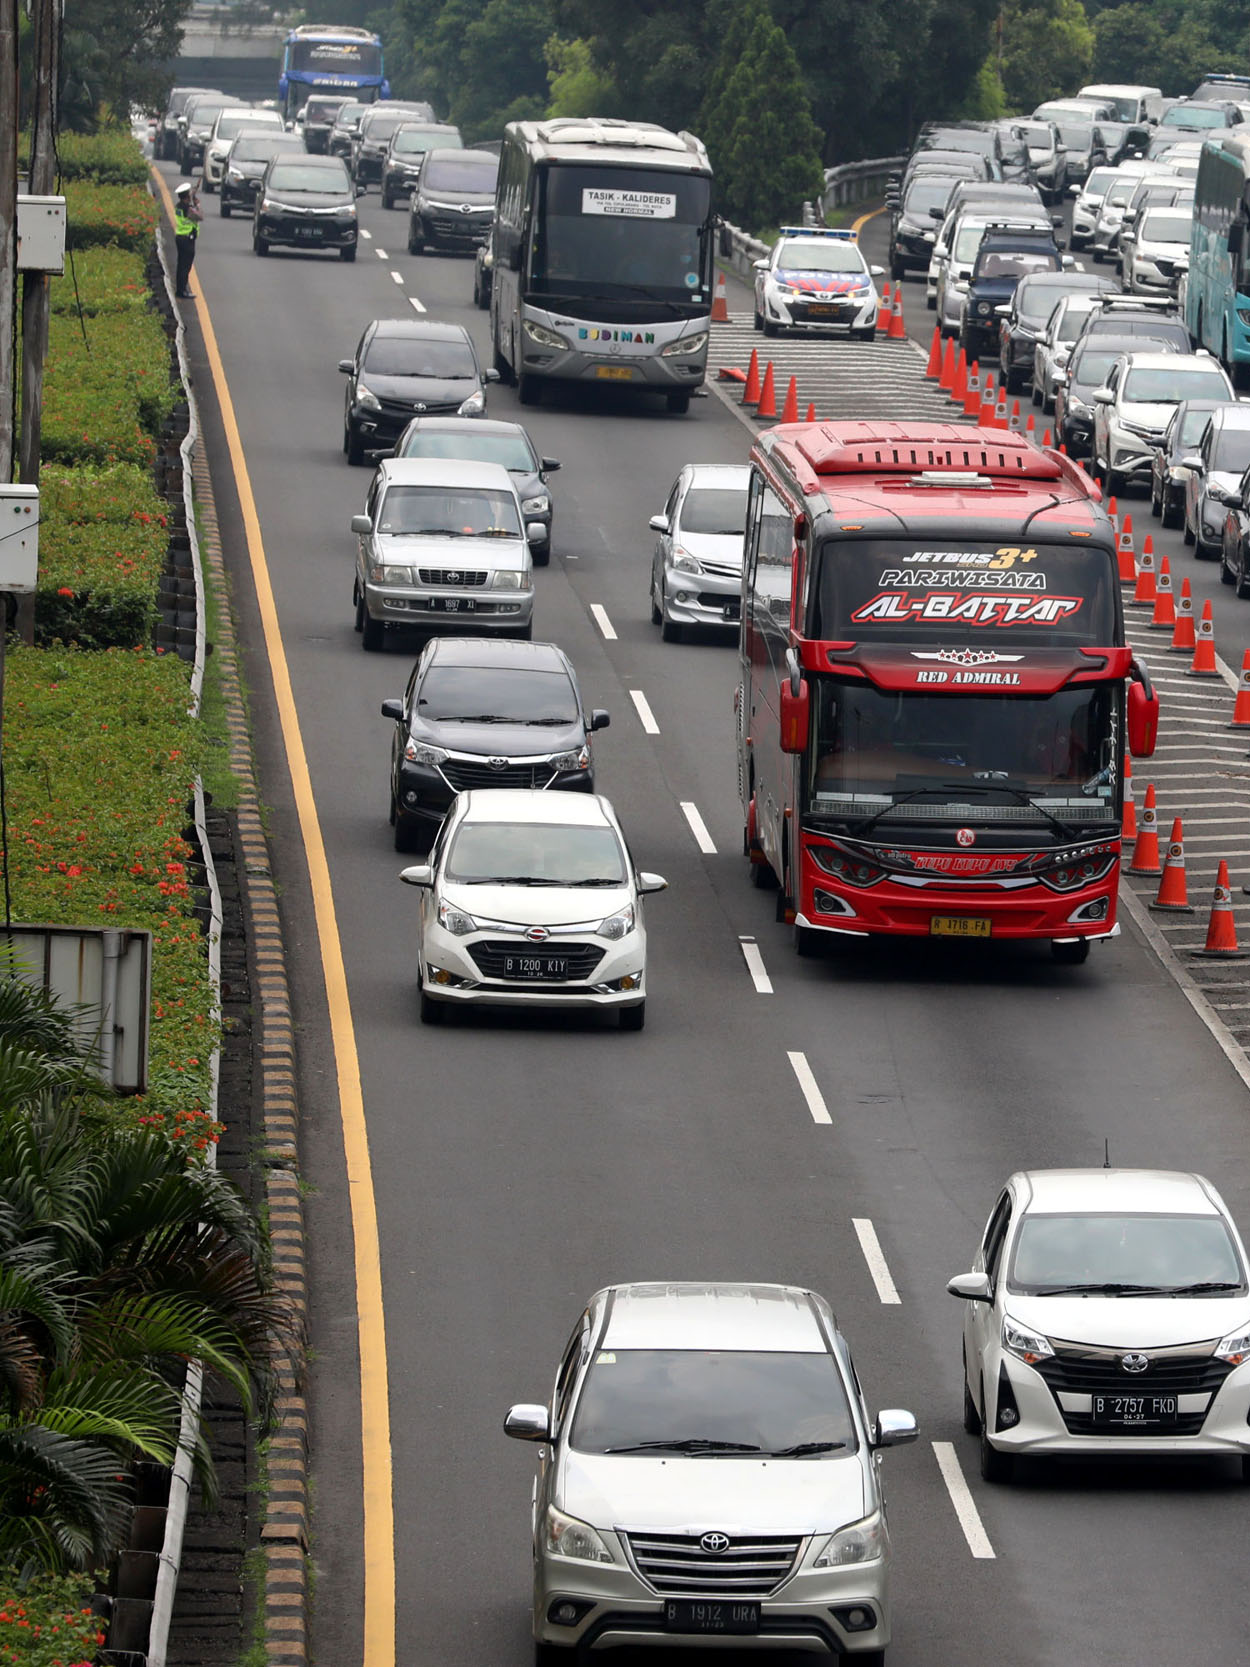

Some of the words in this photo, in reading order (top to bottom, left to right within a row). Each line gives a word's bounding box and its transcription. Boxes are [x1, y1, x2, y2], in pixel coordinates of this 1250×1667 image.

[588, 191, 615, 201] TASIK
[622, 194, 671, 205] KALIDERES
[578, 328, 655, 344] BUDIMAN
[902, 552, 994, 564] JETBUS
[878, 569, 1047, 590] PARIWISATA
[852, 593, 1082, 625] AL-BATTAR
[916, 671, 948, 684] RED
[952, 672, 1021, 686] ADMIRAL
[975, 921, 986, 931] FA
[506, 959, 513, 970] B
[520, 959, 541, 971] 1200
[547, 960, 565, 972] KIY
[1097, 1398, 1105, 1413] B
[1115, 1398, 1145, 1413] 2757
[1152, 1399, 1175, 1413] FKD
[667, 1604, 676, 1620] B
[691, 1605, 721, 1620] 1912
[732, 1606, 757, 1621] URA
